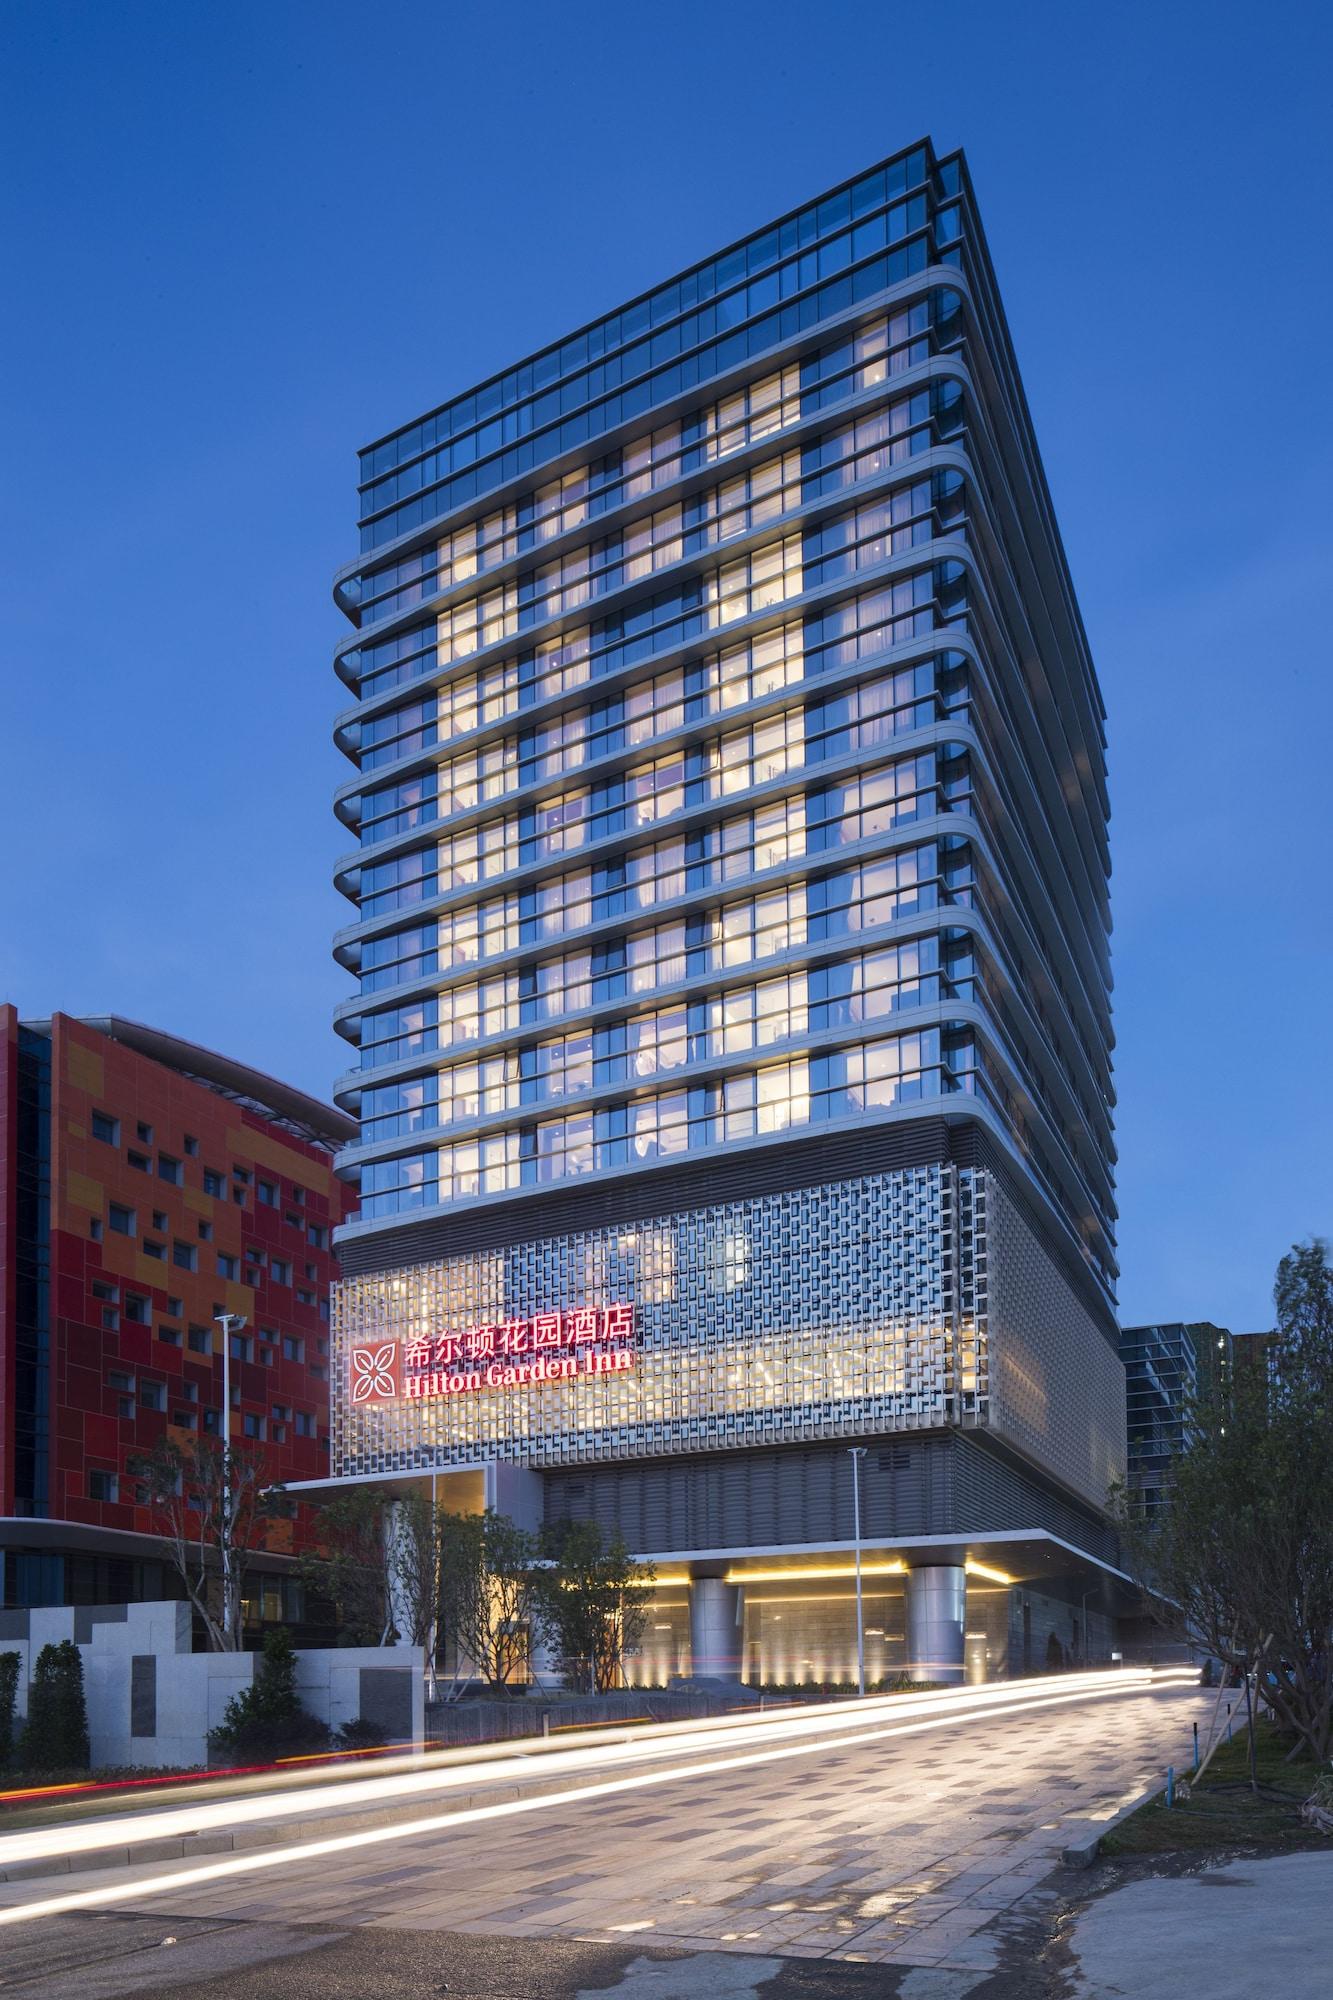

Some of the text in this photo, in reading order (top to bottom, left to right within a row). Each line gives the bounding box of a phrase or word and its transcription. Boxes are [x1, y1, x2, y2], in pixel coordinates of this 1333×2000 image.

[404, 1303, 633, 1368] 希尔顿花园酒店
[403, 1349, 632, 1399] Hilton Garden Inn
